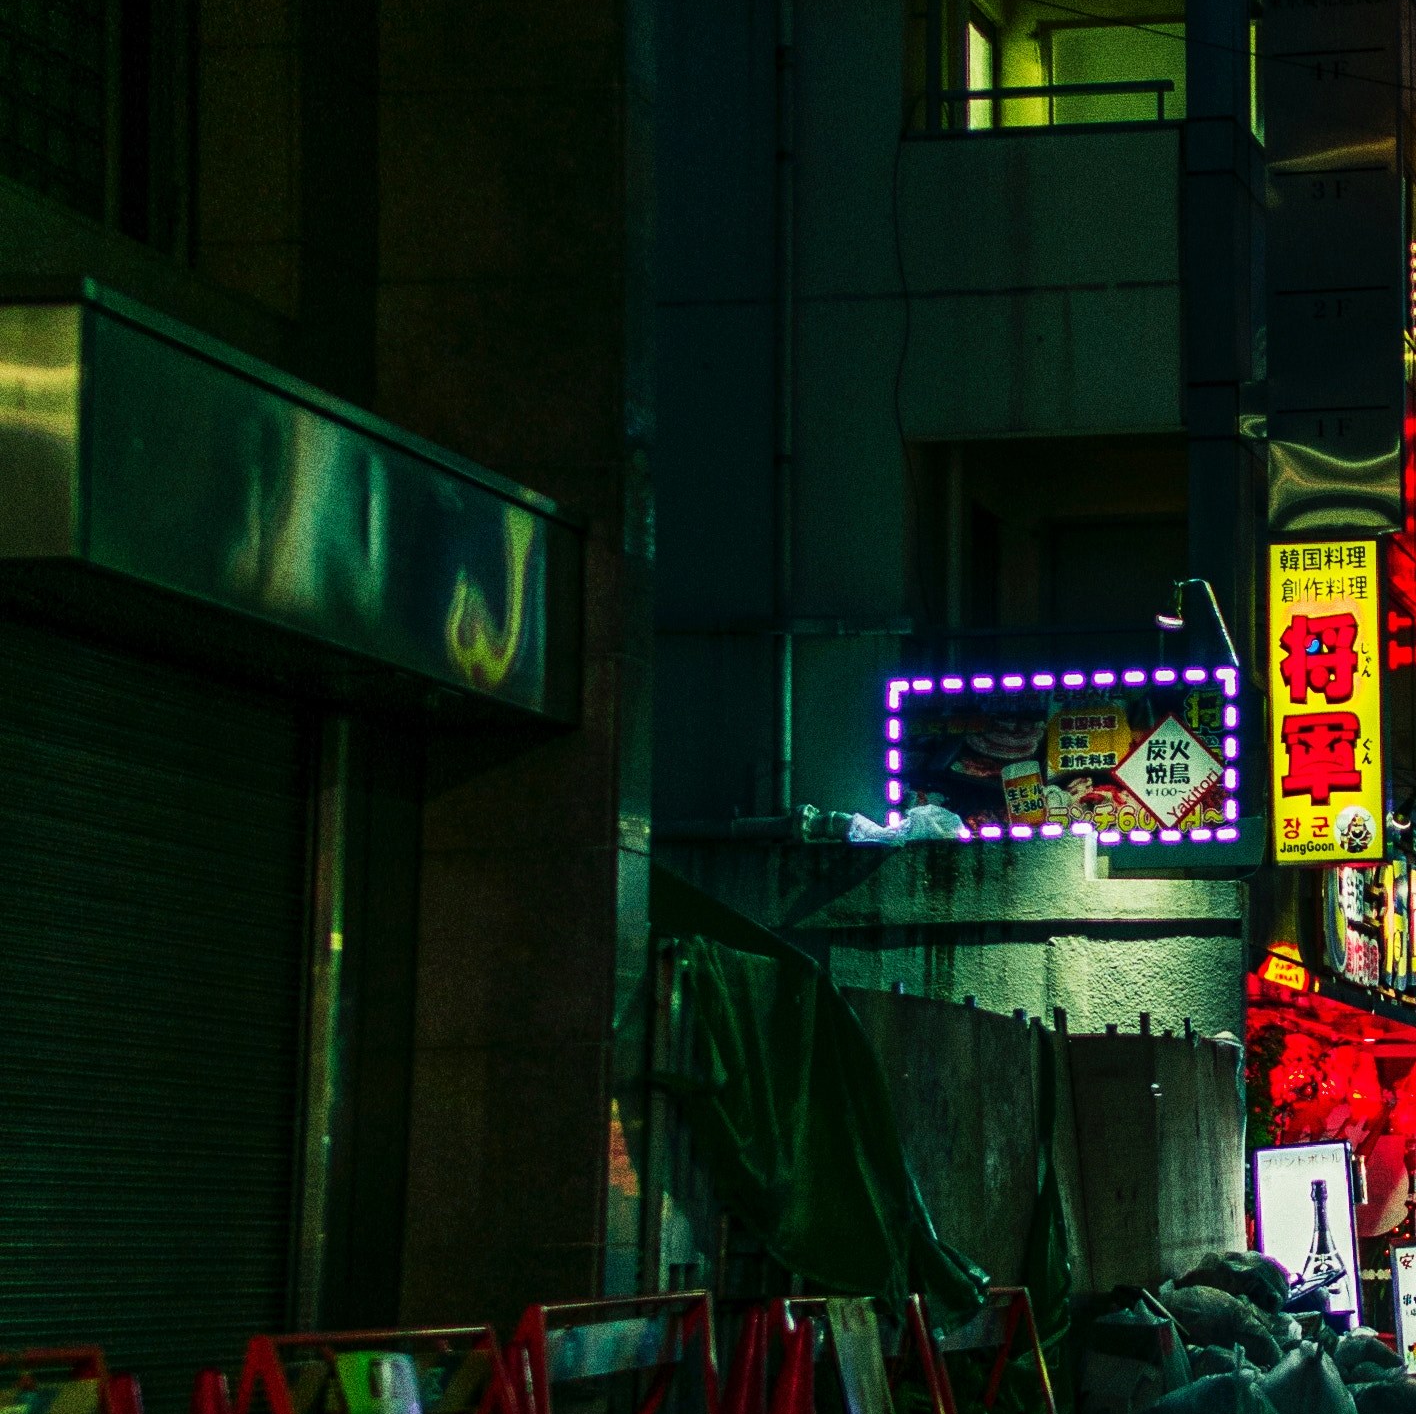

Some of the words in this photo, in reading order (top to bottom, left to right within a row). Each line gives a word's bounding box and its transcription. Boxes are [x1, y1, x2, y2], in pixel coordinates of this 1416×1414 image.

[1279, 545, 1366, 571] 韓国料理
[1281, 575, 1368, 603] 創作料理
[1059, 753, 1118, 769] 創作料理
[1146, 739, 1191, 761] 炭火
[1146, 762, 1191, 785] 焼鳥
[1167, 767, 1221, 823] Yakitori
[1279, 841, 1335, 854] JangGoon
